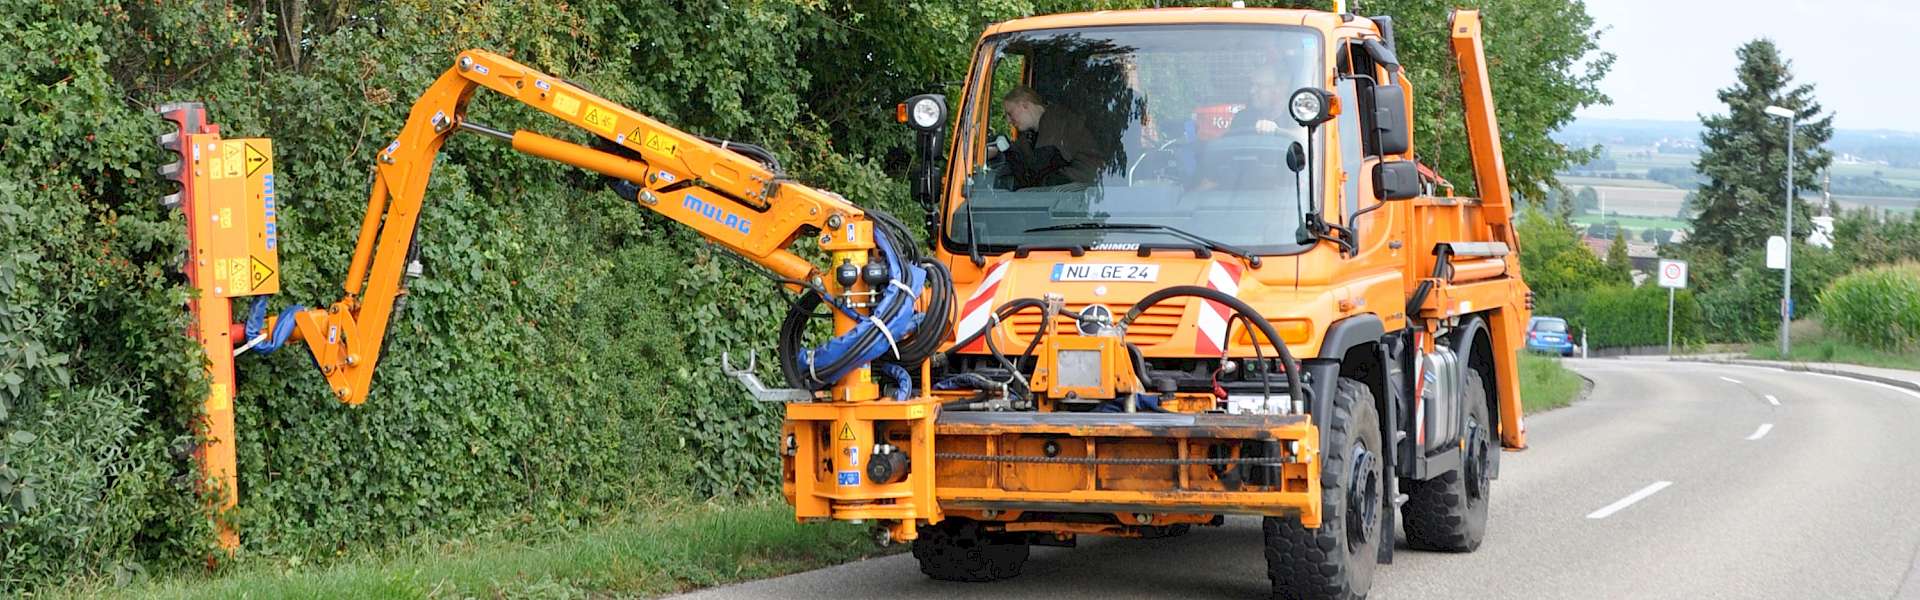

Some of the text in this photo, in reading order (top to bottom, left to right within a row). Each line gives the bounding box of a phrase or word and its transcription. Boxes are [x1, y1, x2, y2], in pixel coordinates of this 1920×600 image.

[1067, 265, 1149, 279] NU GE 24
